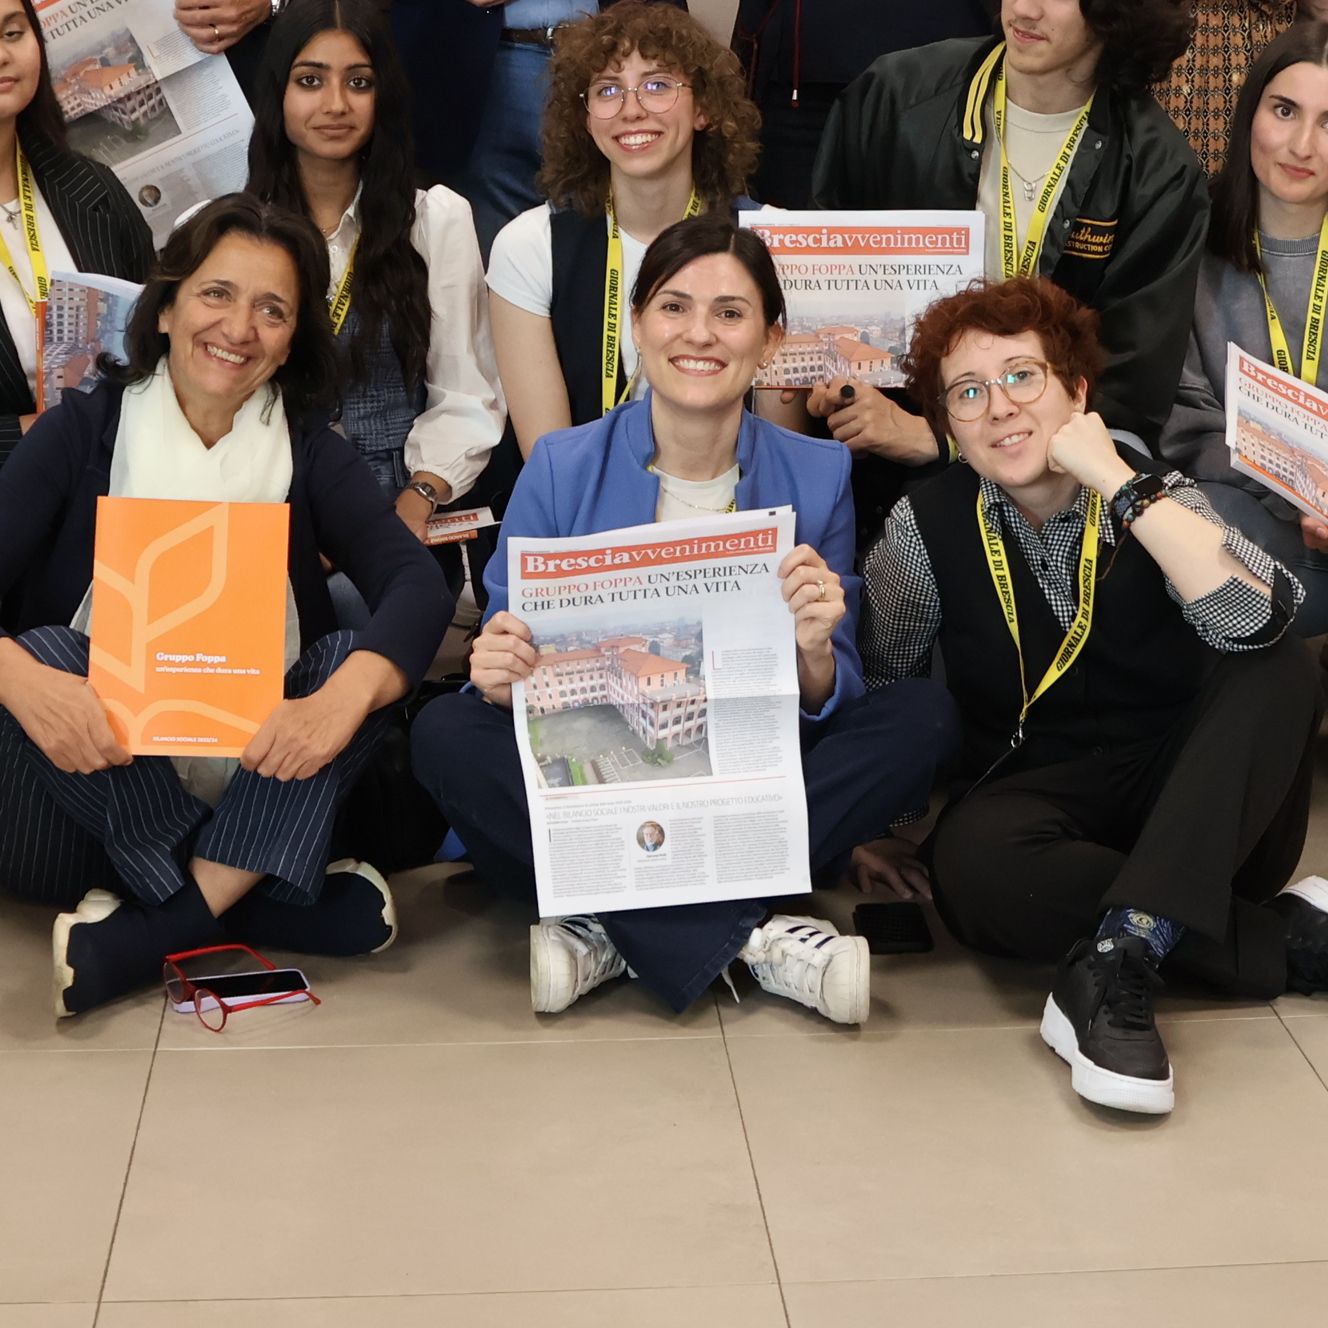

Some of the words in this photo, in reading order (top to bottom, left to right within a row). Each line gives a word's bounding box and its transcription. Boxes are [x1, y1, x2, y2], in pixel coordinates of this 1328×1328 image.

[50, 12, 88, 41] TUTTA
[88, 1, 115, 21] UNA
[1002, 166, 1012, 220] GIORNALE
[1038, 165, 1064, 213] GIORNALE
[23, 213, 40, 252] BRESCIA
[782, 279, 823, 291] DURA
[825, 279, 870, 291] TUTTA
[873, 279, 905, 291] UNA
[906, 279, 939, 291] VITA
[812, 264, 855, 275] FOPPA
[858, 263, 963, 275] UN'ESPERIENZA
[608, 268, 619, 320] GIORNALE
[605, 335, 617, 379] BRESCIA
[1306, 316, 1320, 361] BRESCIA
[1238, 385, 1263, 407] CHE
[1265, 401, 1299, 427] DURA
[1239, 377, 1289, 408] GRUPPO
[524, 530, 774, 574] Bresciavvenimenti
[521, 583, 589, 599] GRUPPO
[593, 576, 643, 591] FOPPA
[647, 562, 770, 584] UN'ESPERIENZA
[521, 599, 556, 613] CHE
[559, 594, 605, 609] DURA
[607, 588, 660, 604] TUTTA
[665, 583, 700, 597] UNA
[703, 580, 741, 593] VITA
[996, 574, 1015, 624] BRESCIA
[1055, 622, 1088, 672] GIORNALE
[1082, 558, 1094, 608] BRESCIA
[156, 652, 194, 662] Gruppo
[196, 653, 226, 663] Foppa
